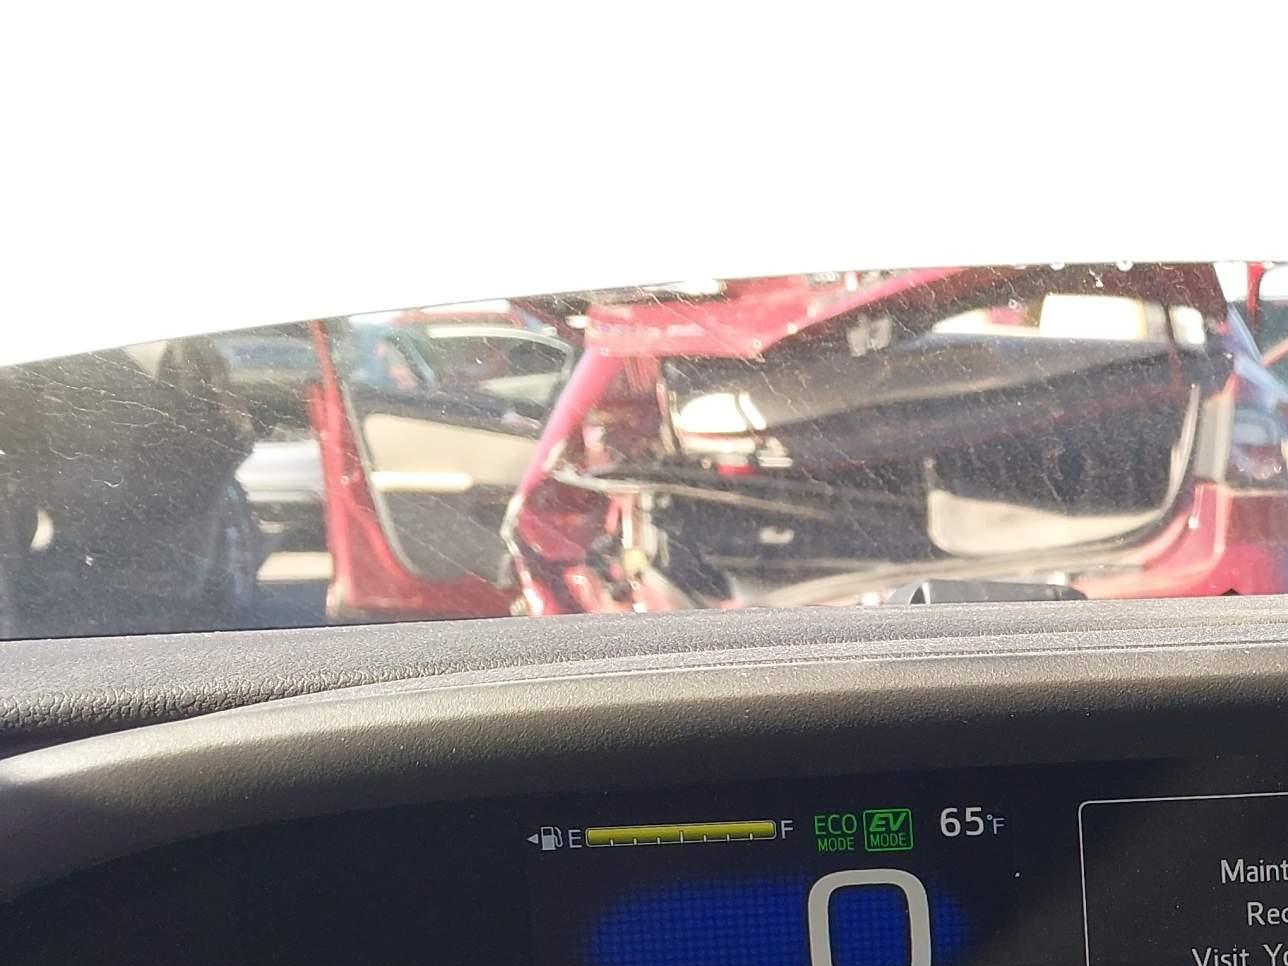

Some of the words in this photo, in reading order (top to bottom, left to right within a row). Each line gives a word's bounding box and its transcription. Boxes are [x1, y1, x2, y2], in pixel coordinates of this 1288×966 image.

[781, 820, 793, 839] F
[814, 813, 857, 835] ECO
[869, 812, 907, 831] EV
[569, 829, 582, 849] E
[818, 836, 855, 851] MODE
[870, 832, 907, 848] MODE
